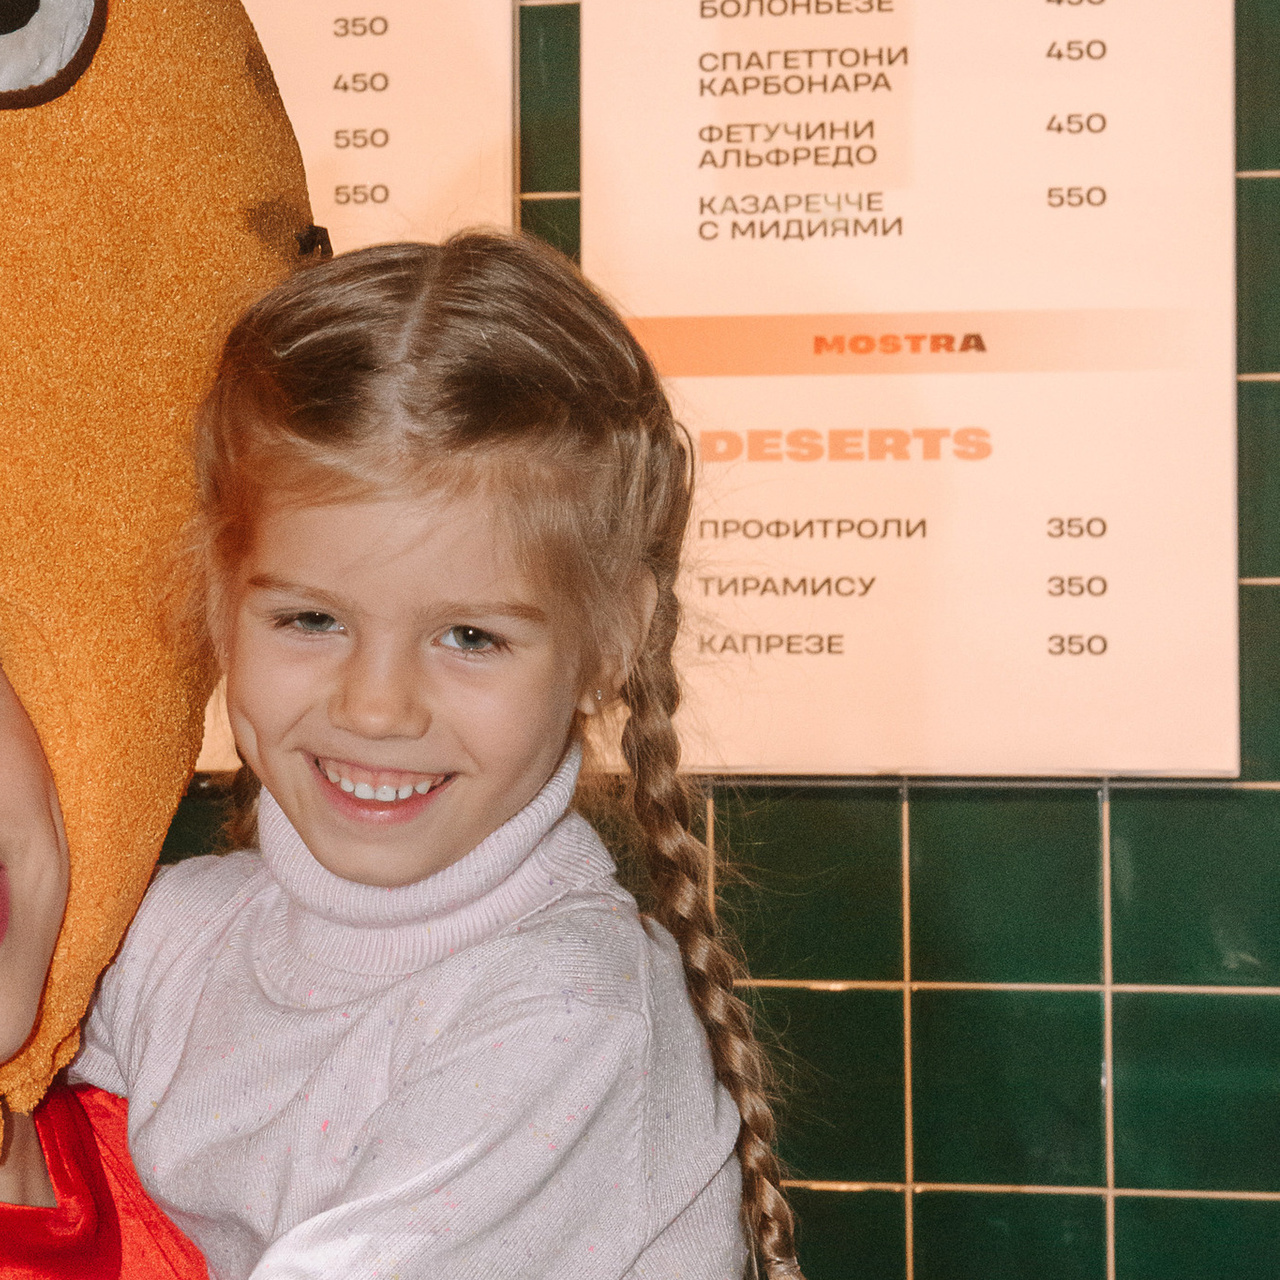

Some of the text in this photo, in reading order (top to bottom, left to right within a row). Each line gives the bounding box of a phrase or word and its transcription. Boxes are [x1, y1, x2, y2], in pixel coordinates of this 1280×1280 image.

[332, 16, 389, 37] 350
[698, 39, 1107, 73] СПАГЕТТОНИ 450
[332, 72, 389, 93] 450
[698, 72, 893, 97] КАРБОНАРА
[333, 128, 390, 149] 550
[698, 112, 1107, 144] ФЕТУЧИНИ 450
[698, 145, 878, 169] АЛЬФРЕДО
[333, 184, 390, 205] 550
[698, 185, 1108, 216] КАЗАРЕЧЧЕ 550
[698, 216, 904, 242] С МИДИЯМИ
[813, 332, 988, 355] MOSTRA
[700, 426, 993, 463] DESERTS
[699, 517, 1108, 539] ПРОФИТРОЛИ 350
[697, 575, 1108, 597] ТИРАМИСУ 350
[698, 633, 1108, 656] КАПРЕЗЕ 350
